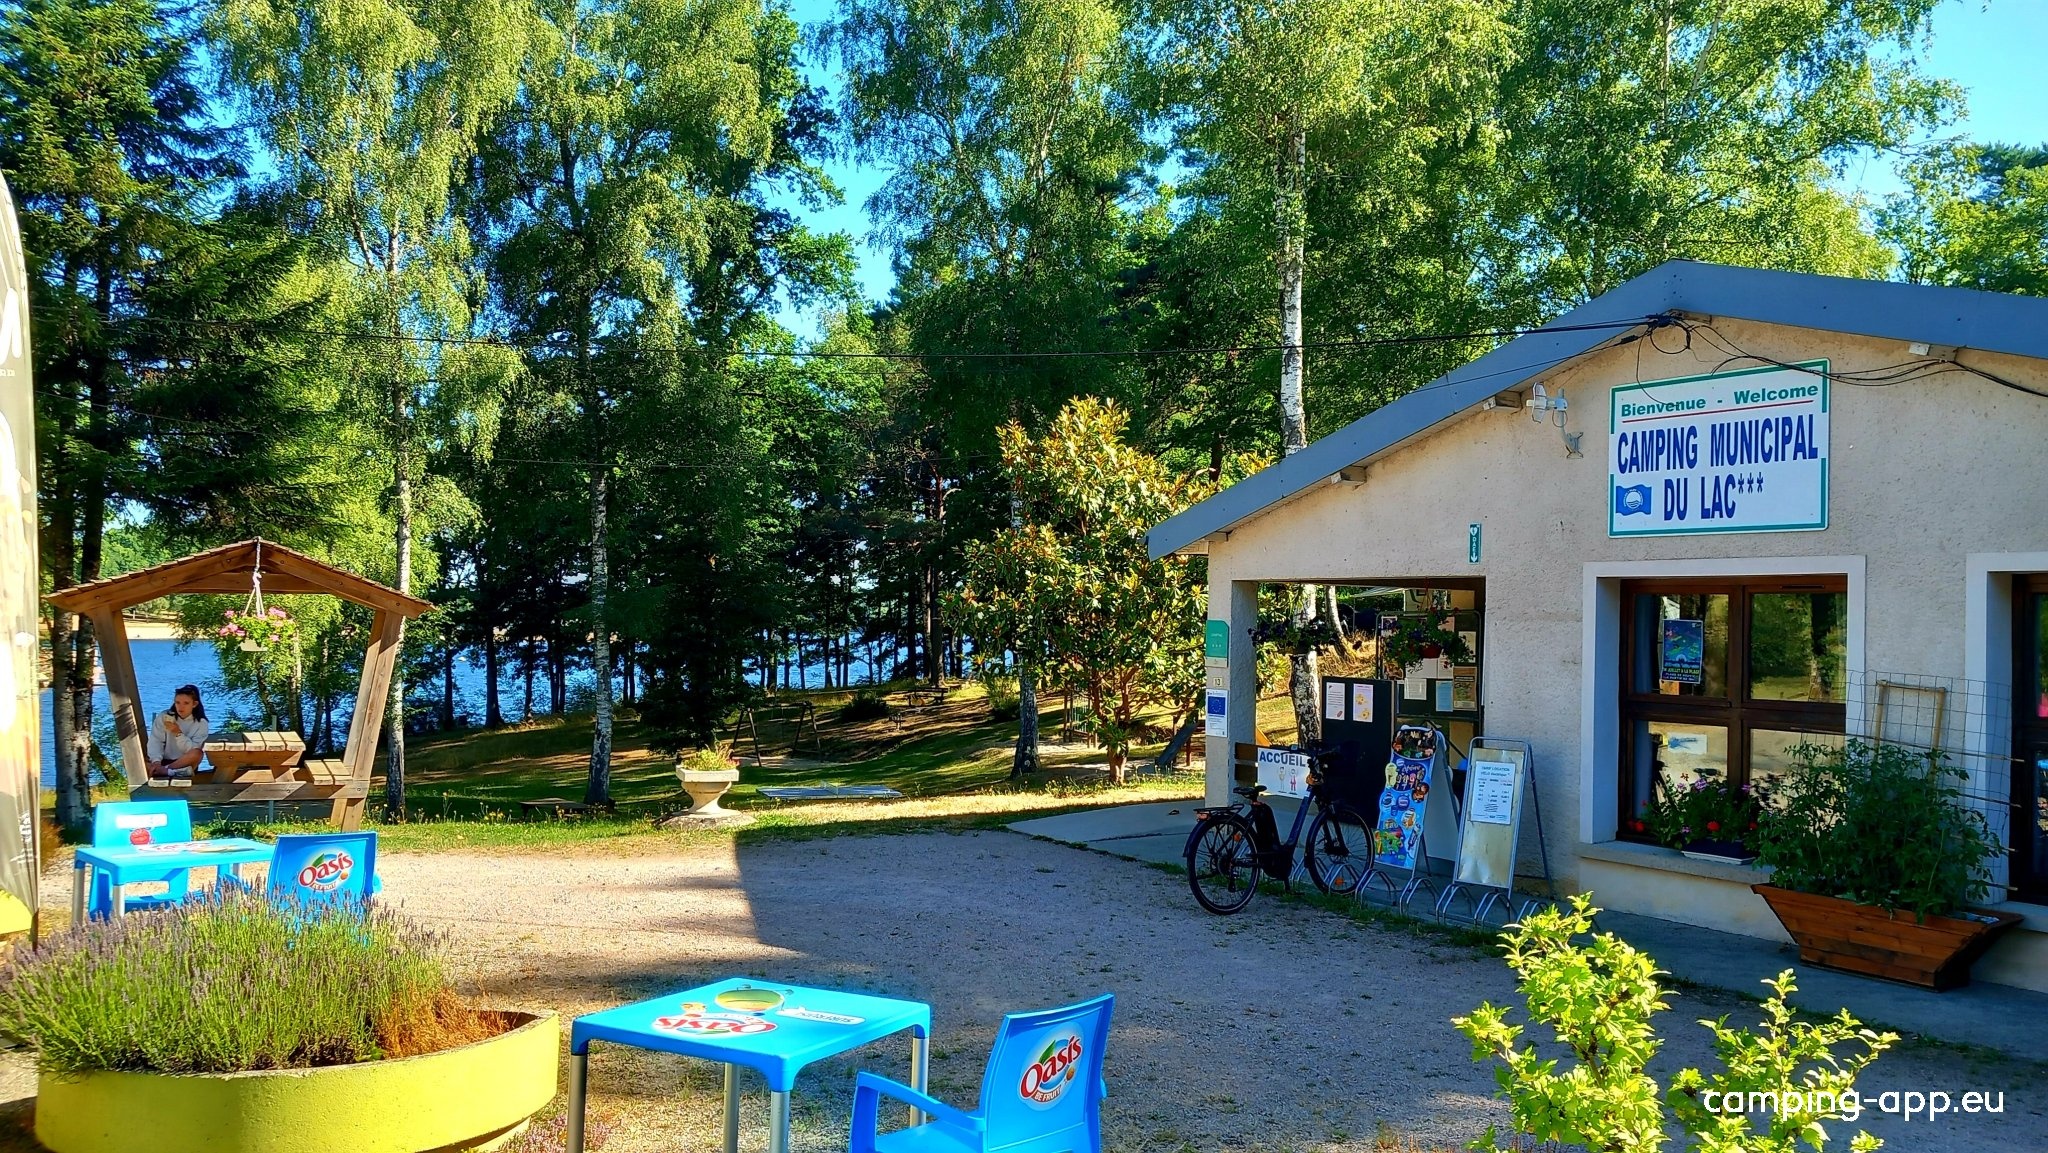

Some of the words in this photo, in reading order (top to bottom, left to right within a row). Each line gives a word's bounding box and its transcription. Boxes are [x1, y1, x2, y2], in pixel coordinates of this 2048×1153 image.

[1621, 397, 1706, 417] Bienvenue
[1733, 384, 1819, 405] Welcome
[1617, 425, 1698, 474] CAMPING
[1710, 413, 1818, 468] MUNICIPAL
[1663, 477, 1688, 521] DU
[1259, 751, 1306, 767] ACCUEIL
[299, 852, 353, 886] Oasis
[658, 1017, 776, 1033] Oasis
[1020, 1035, 1082, 1098] Oasis
